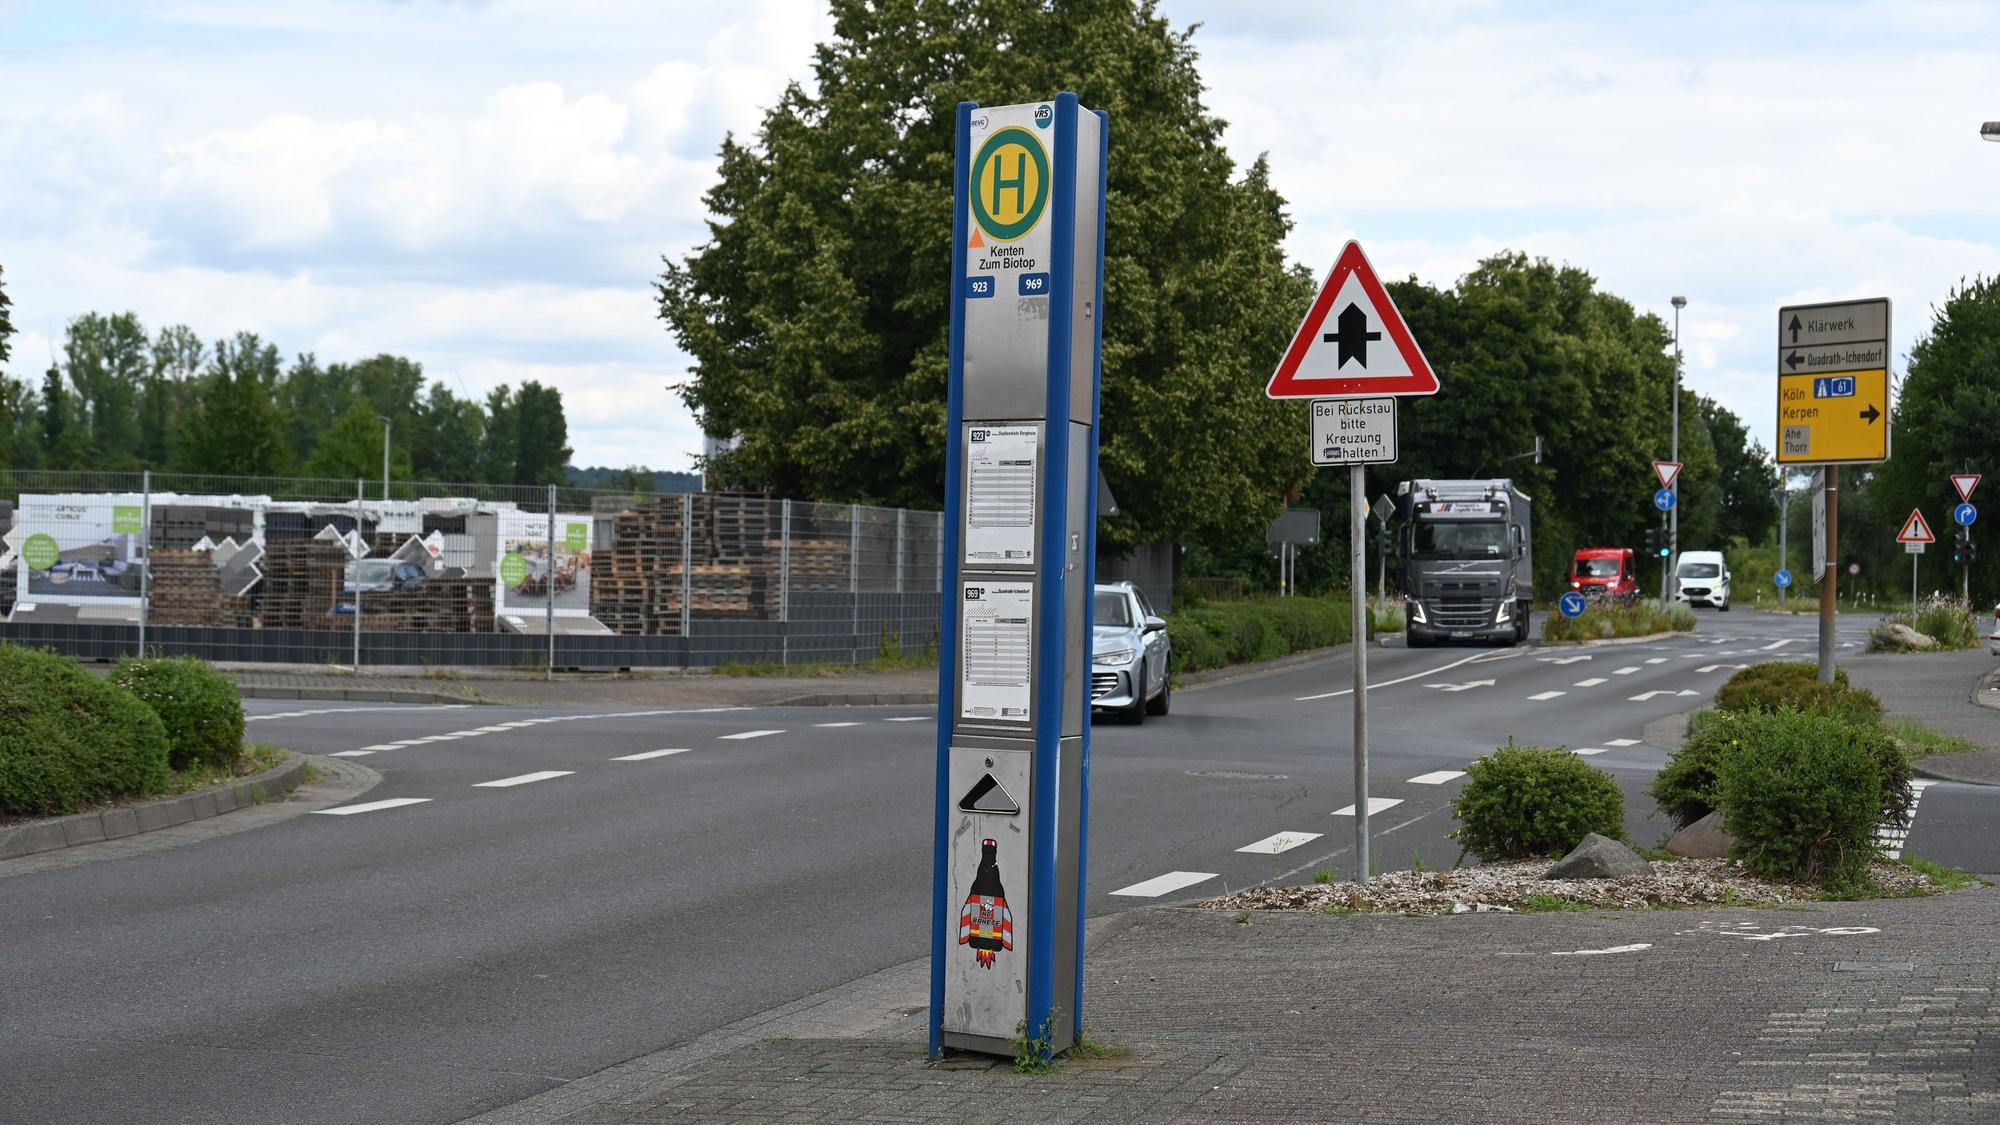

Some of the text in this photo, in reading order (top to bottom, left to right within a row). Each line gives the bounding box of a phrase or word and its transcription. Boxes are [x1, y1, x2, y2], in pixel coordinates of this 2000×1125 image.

[1034, 109, 1049, 119] VRS
[993, 153, 1026, 215] H
[990, 246, 1024, 257] Kenten
[979, 257, 1036, 270] Zum Biotop
[972, 282, 988, 292] 923
[1025, 279, 1042, 290] 969
[1808, 317, 1855, 333] Klärwerk
[1807, 349, 1882, 367] Quadrath-Ichendorf
[1837, 380, 1847, 393] 61
[1783, 388, 1805, 401] Köln
[1316, 404, 1391, 417] Bei Rückstau
[1783, 407, 1819, 421] Kerpen
[1340, 419, 1366, 430] bitte
[972, 431, 984, 441] 923
[1785, 428, 1801, 439] Ahe
[1326, 434, 1381, 446] Kreuzung
[1785, 442, 1808, 453] Thorr
[967, 589, 979, 598] 969
